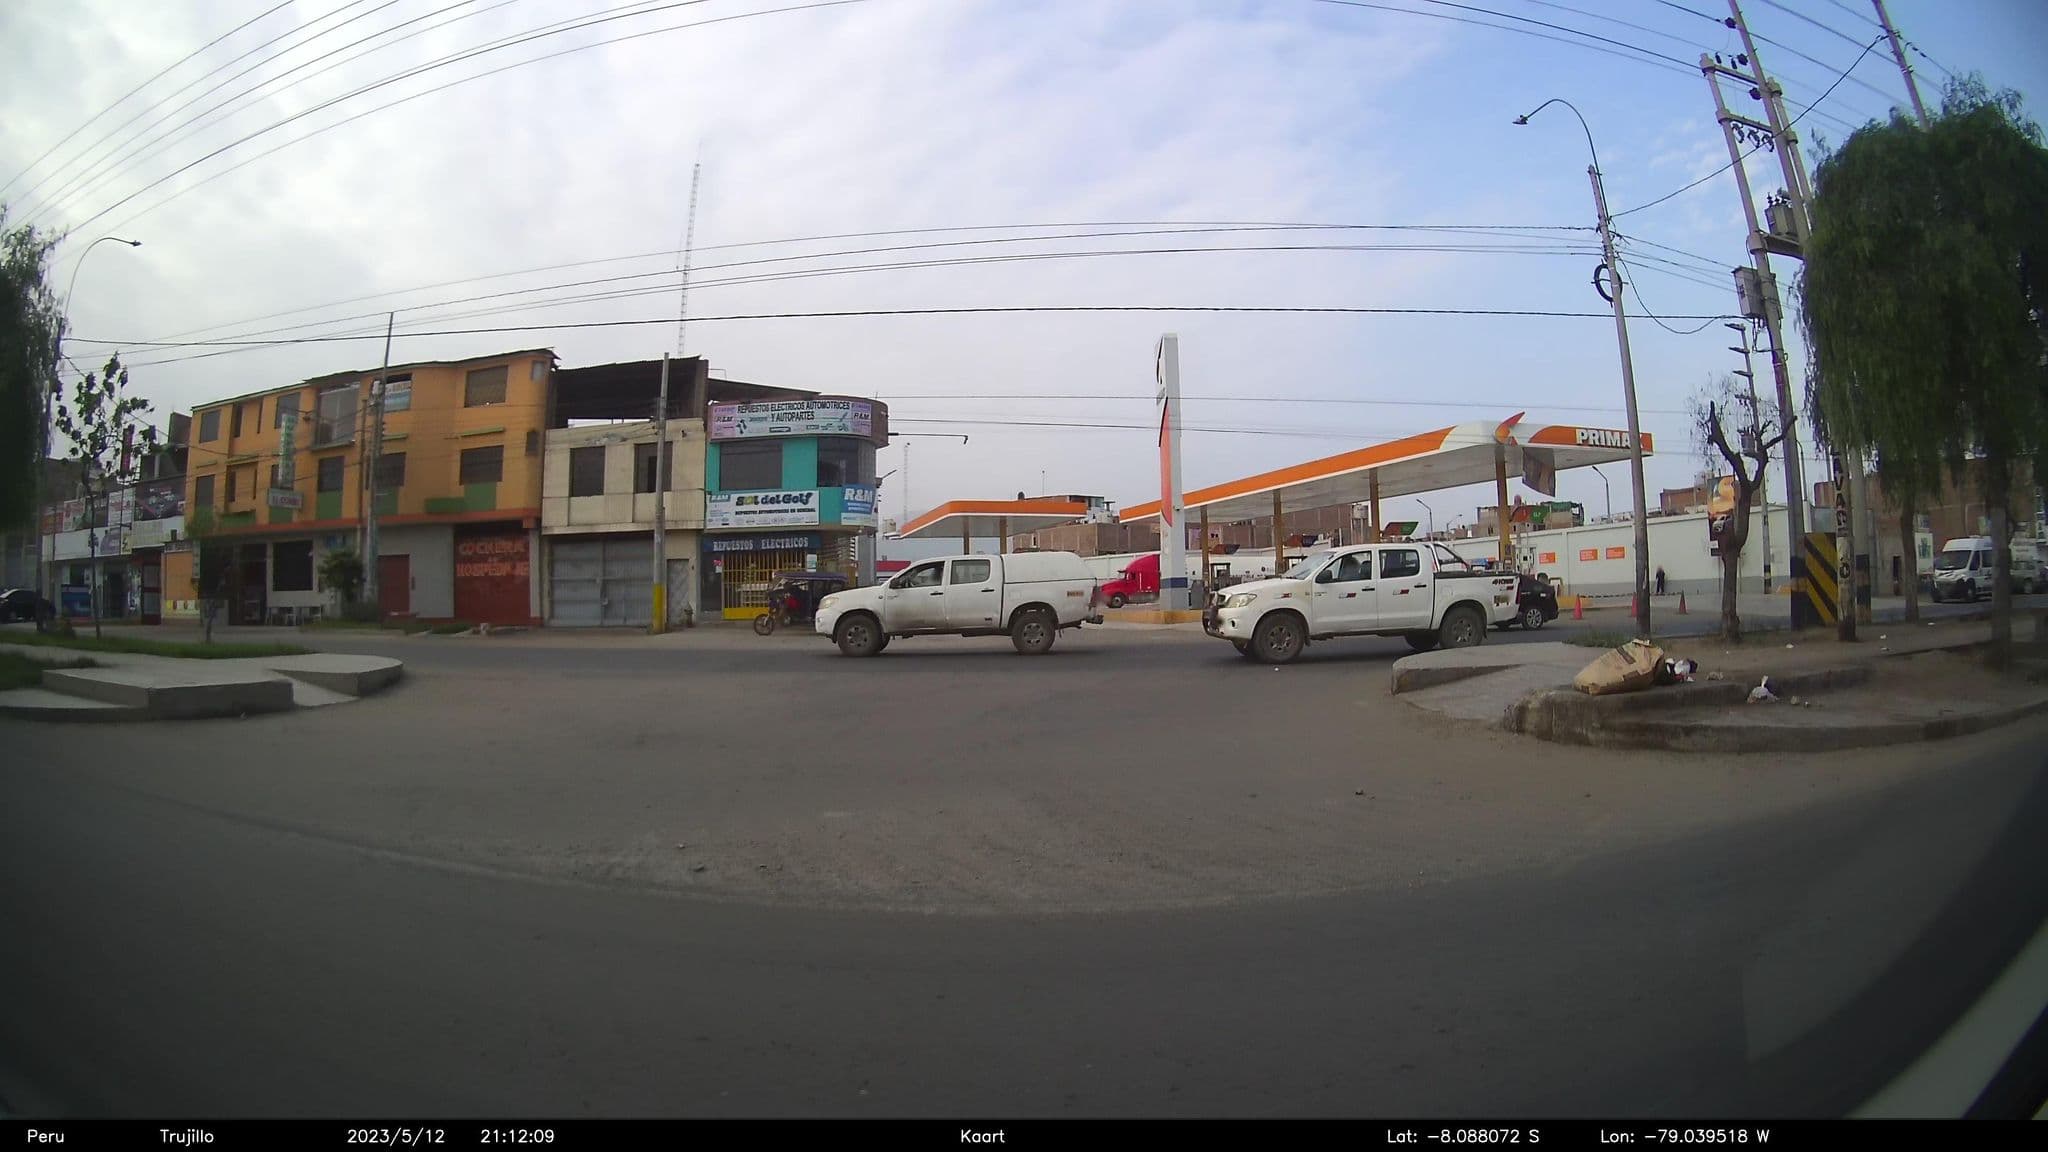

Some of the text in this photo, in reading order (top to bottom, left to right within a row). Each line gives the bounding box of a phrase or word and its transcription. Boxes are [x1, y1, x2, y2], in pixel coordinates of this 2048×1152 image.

[737, 404, 769, 414] REPUESTOS
[771, 402, 805, 412] ELECTRICOS
[806, 400, 850, 411] AUTOMOTRICES
[776, 411, 815, 422] AUTOPARTES
[1575, 428, 1644, 450] PRIMA
[844, 488, 873, 502] R&M
[713, 537, 809, 552] REPUESTOS ELECTRICOS
